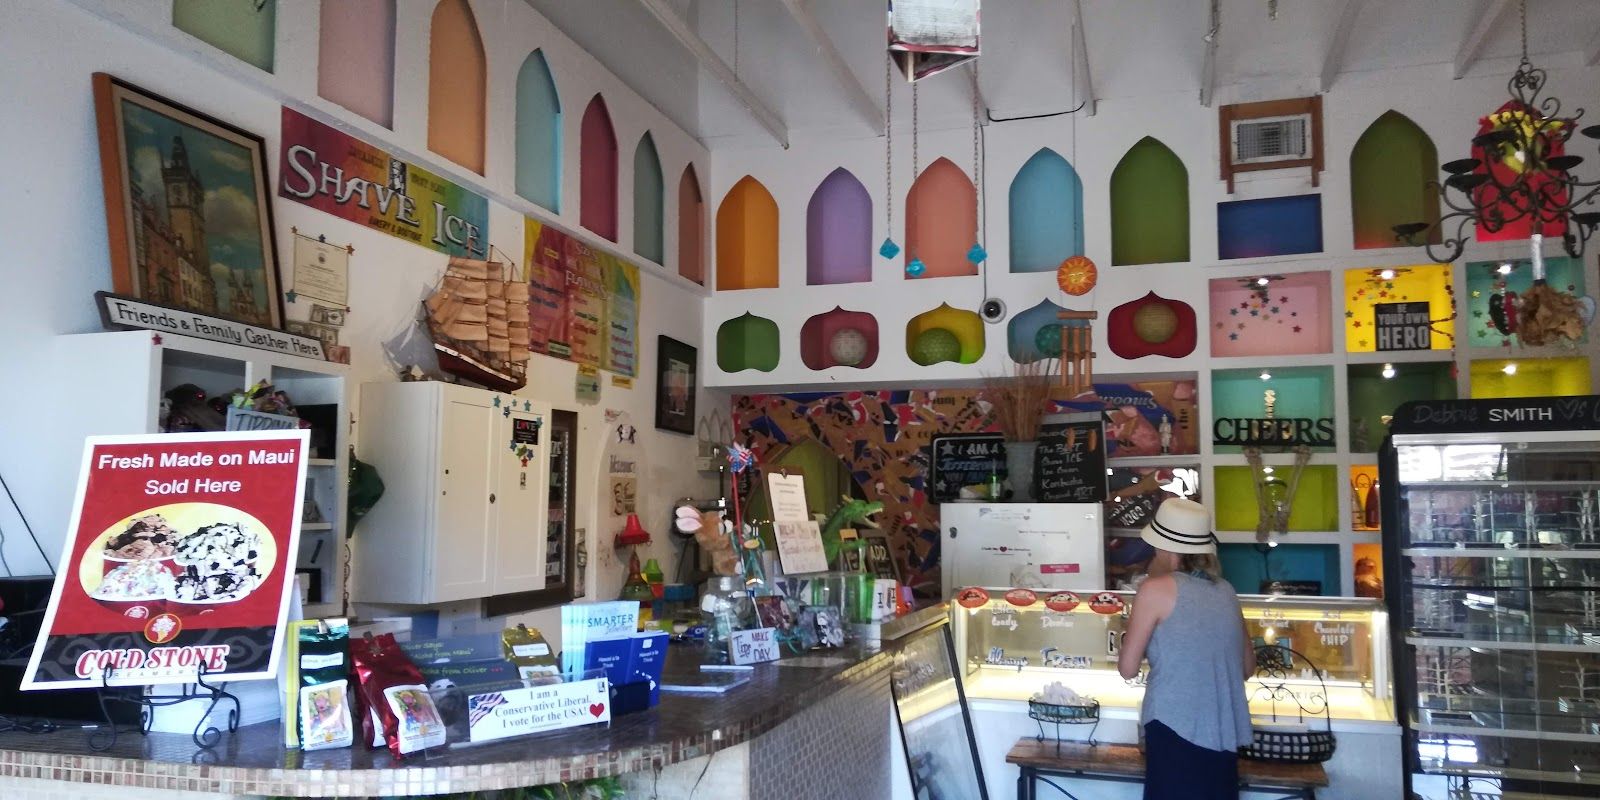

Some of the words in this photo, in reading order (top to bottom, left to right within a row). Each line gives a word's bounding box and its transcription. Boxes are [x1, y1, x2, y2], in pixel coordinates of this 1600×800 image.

[284, 145, 420, 227] SHAVE
[432, 201, 484, 255] ICE
[116, 302, 177, 329] Friends
[180, 319, 190, 330] &
[193, 318, 243, 343] Family
[245, 328, 289, 349] Gather
[290, 338, 320, 355] Here
[1378, 313, 1404, 325] YOUR
[1405, 312, 1429, 324] OWN
[1378, 326, 1430, 349] HERO
[1489, 408, 1553, 422] SMITH
[1213, 417, 1335, 445] CHEERS
[98, 454, 154, 469] Fresh
[160, 452, 213, 468] Made
[218, 454, 243, 467] on
[248, 449, 295, 465] Maui
[145, 479, 189, 495] Sold
[195, 478, 242, 493] Here
[588, 614, 634, 628] SMARTER
[78, 651, 143, 676] COLD
[148, 646, 227, 670] STONE
[529, 691, 534, 700] I
[495, 701, 555, 717] Conservative
[503, 719, 507, 728] I
[510, 718, 529, 727] vote
[532, 714, 544, 723] for
[547, 711, 561, 720] the
[564, 707, 588, 719] USA!
